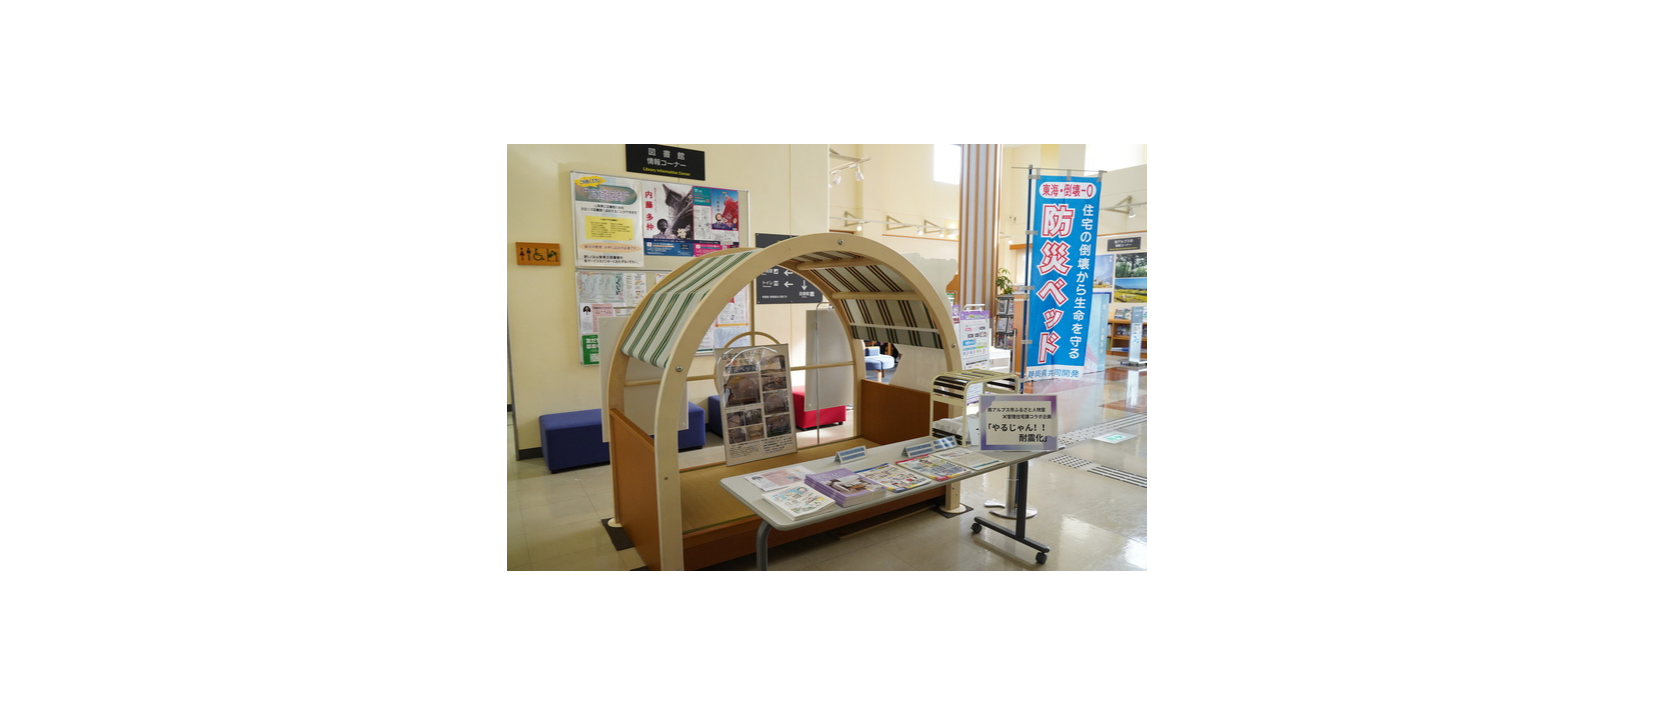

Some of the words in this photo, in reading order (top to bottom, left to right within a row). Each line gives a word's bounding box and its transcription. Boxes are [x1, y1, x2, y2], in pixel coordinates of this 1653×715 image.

[648, 147, 685, 161] 図書館
[646, 157, 687, 168] 情報コーナー
[1036, 203, 1076, 364] 防災ベッド
[1068, 203, 1095, 359] 住宅の倒壊から生命を守る
[1028, 368, 1080, 379] 静岡県共同開発
